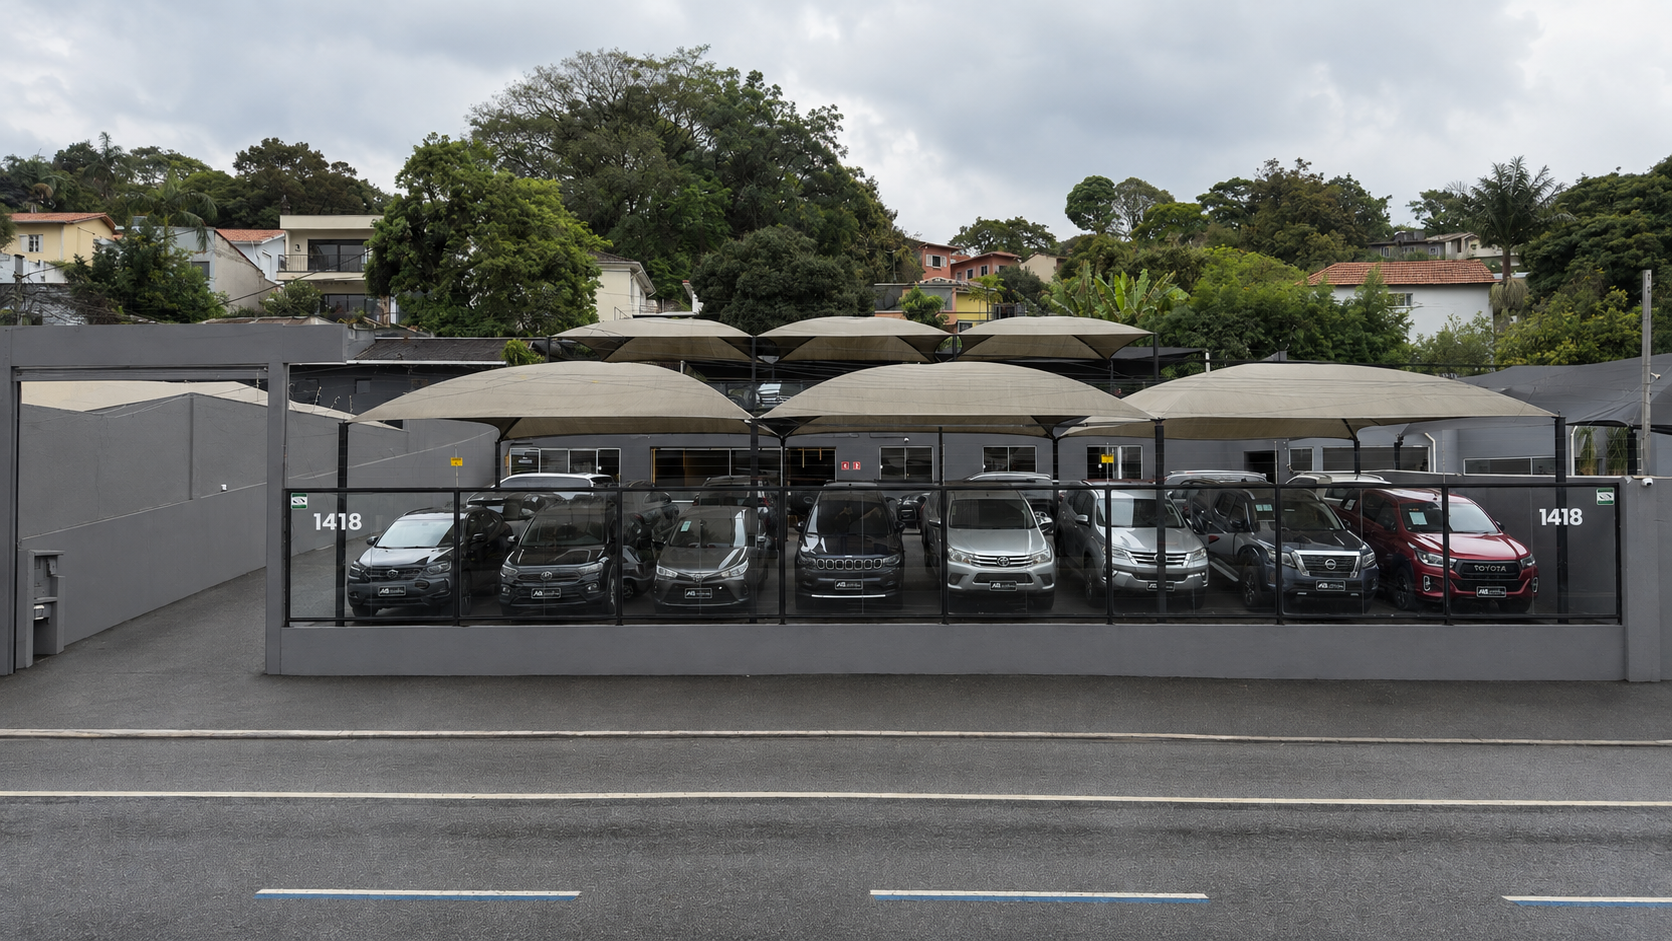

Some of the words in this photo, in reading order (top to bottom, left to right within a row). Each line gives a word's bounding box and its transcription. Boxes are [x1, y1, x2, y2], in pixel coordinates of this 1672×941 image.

[313, 512, 362, 530] 1418
[1539, 508, 1583, 526] 1418
[1474, 564, 1506, 572] TOYOTA
